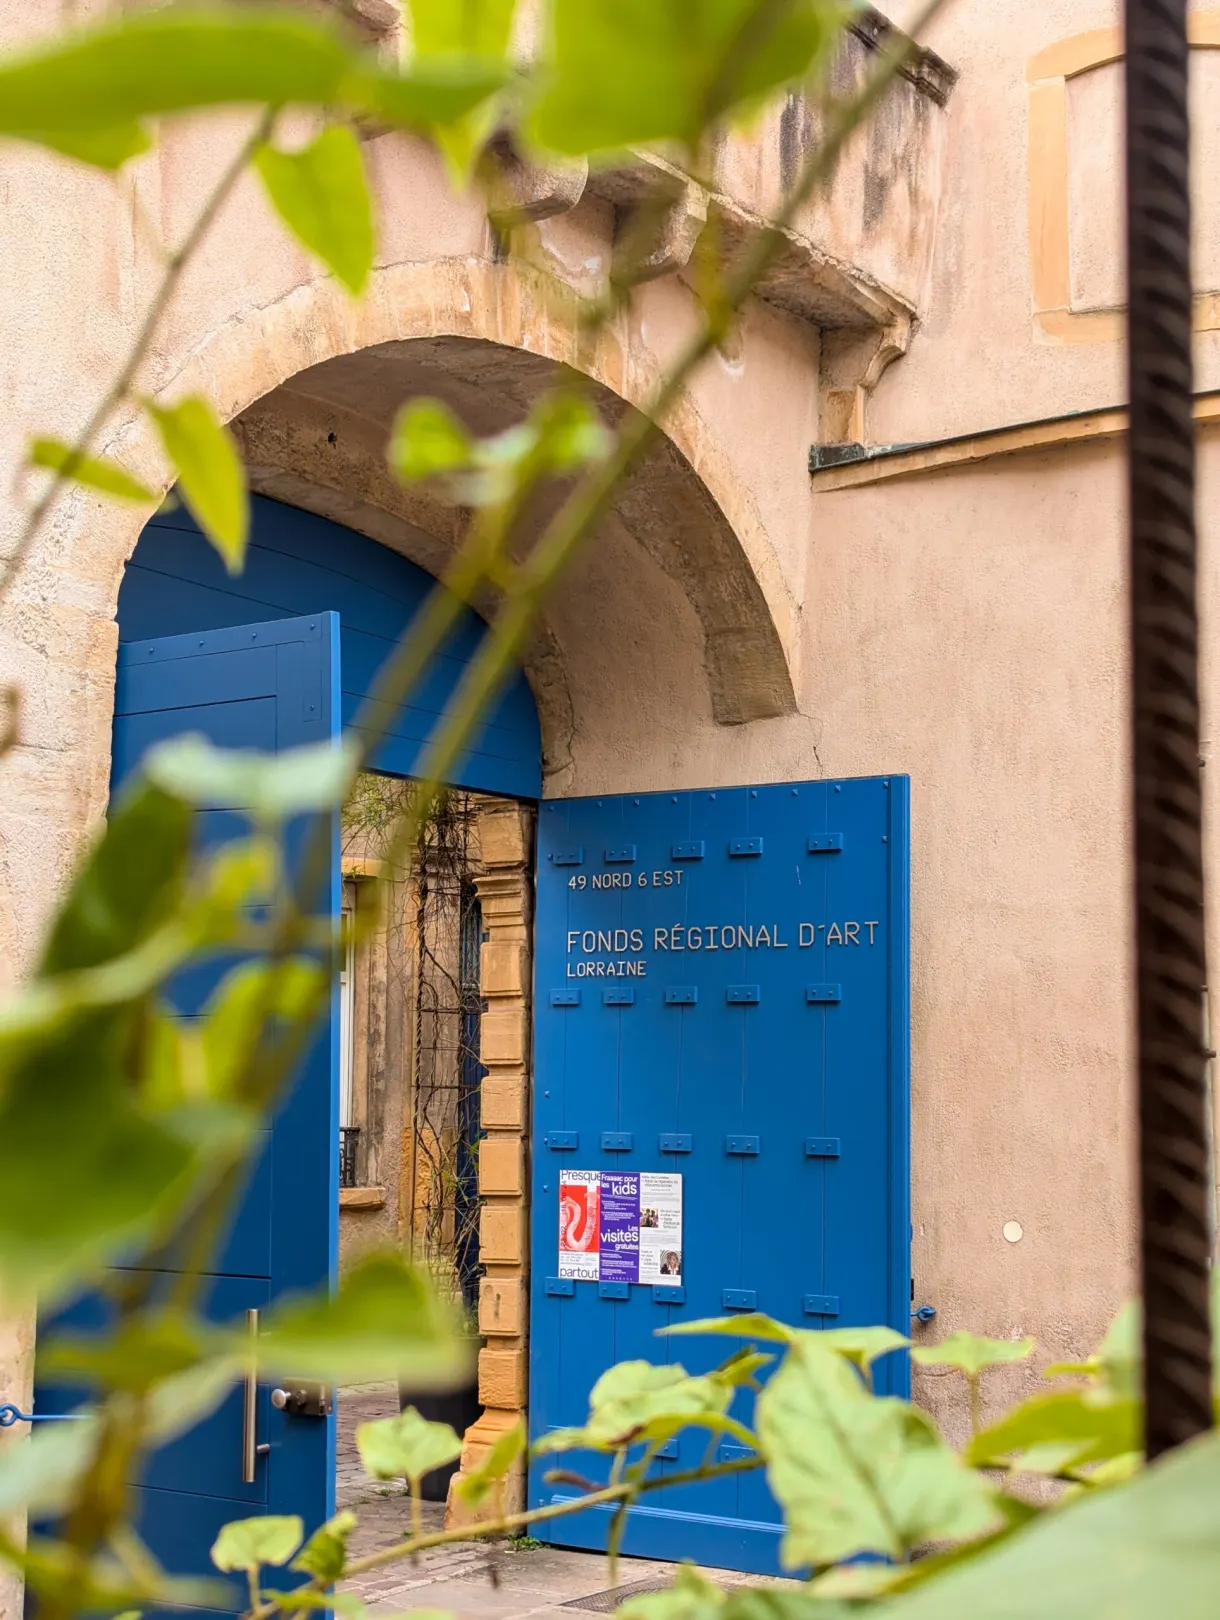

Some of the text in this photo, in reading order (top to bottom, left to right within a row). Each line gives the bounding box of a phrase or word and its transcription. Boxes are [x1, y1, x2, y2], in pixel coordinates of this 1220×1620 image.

[568, 870, 684, 890] 49 NORD 6 EST
[567, 920, 879, 953] FONDS RÉGIONAL D'ART
[567, 960, 647, 977] LORRAINE
[561, 1170, 601, 1184] Presque
[624, 1175, 638, 1184] pour
[612, 1181, 638, 1196] kids
[600, 1229, 639, 1243] visites
[560, 1267, 599, 1279] partout
